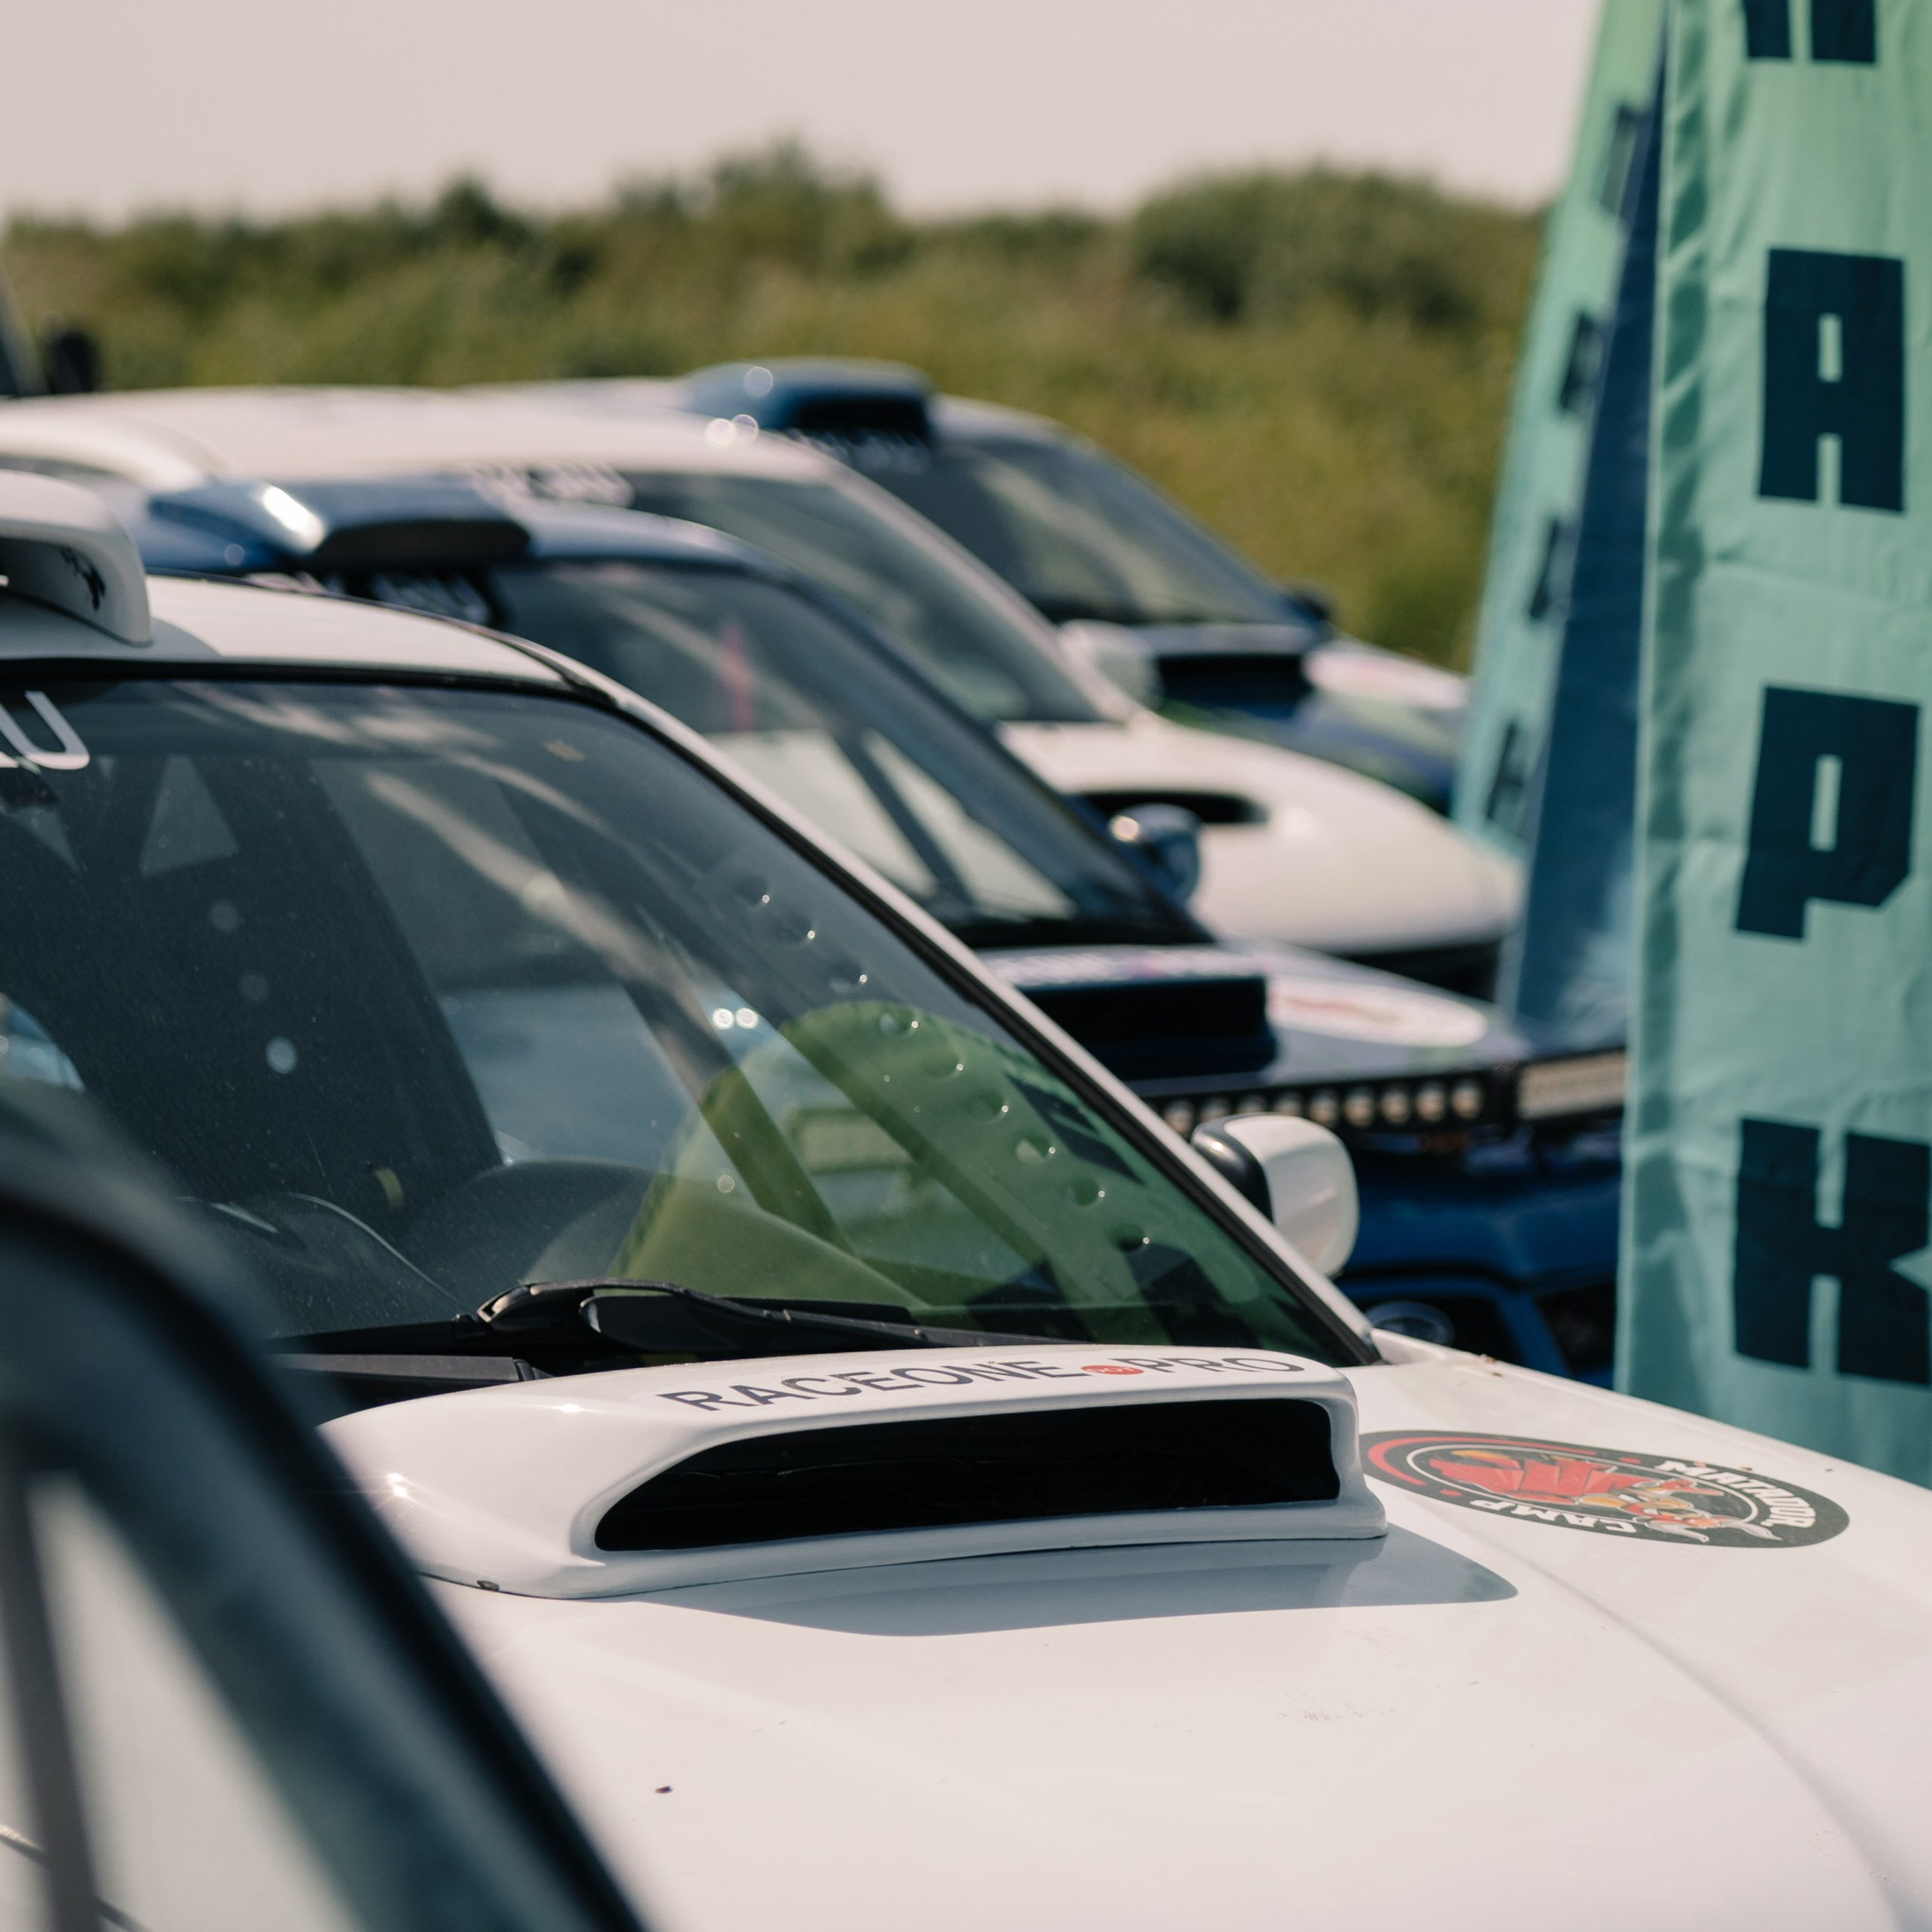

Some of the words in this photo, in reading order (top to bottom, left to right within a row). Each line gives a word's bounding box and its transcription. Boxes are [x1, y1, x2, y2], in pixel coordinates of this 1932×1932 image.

[1734, 0, 1932, 1387] АРК
[655, 1361, 1093, 1411] RACEONE
[1107, 1358, 1305, 1373] PRO
[1470, 1500, 1637, 1533] CAMP
[1654, 1460, 1816, 1528] MATADOR
